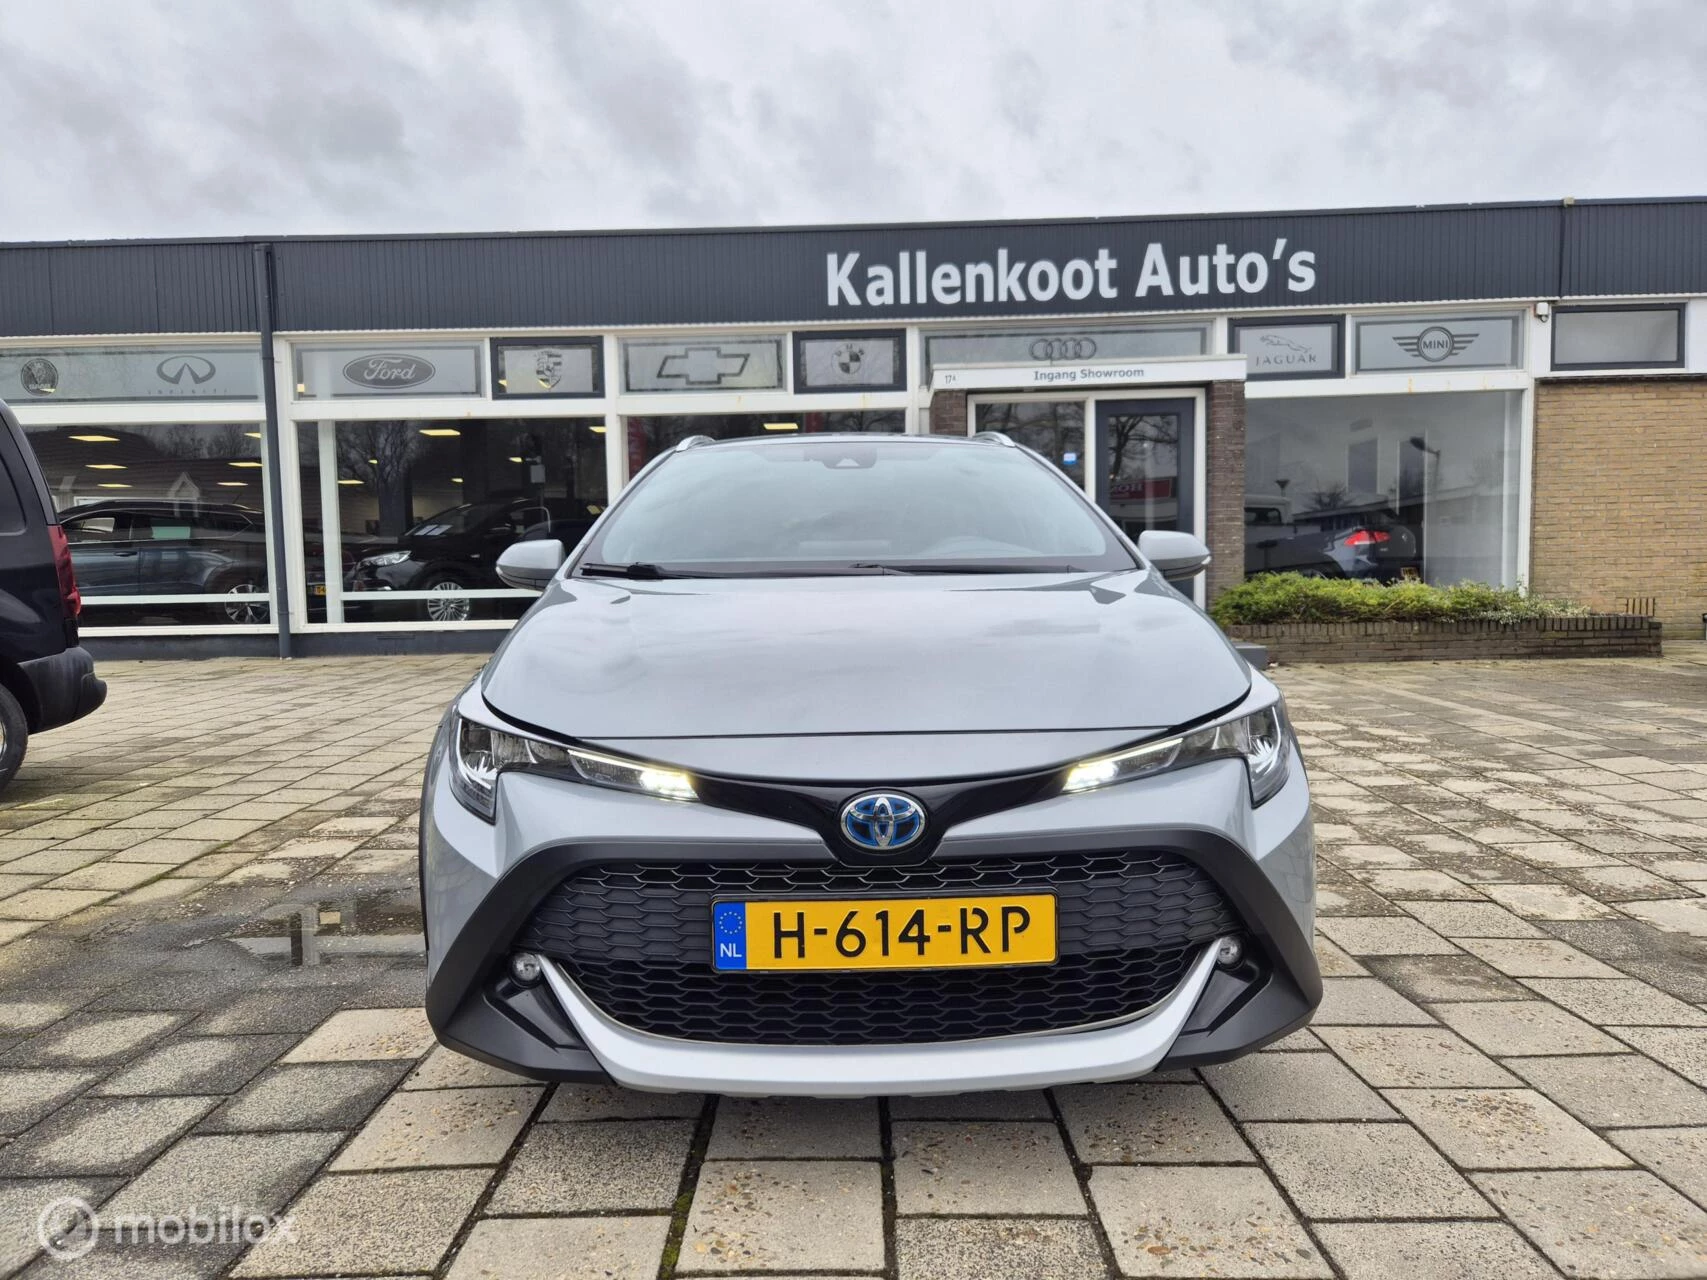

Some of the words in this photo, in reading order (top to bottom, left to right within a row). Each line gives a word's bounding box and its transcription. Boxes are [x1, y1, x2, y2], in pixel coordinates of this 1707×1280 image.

[827, 249, 1118, 306] Kallenkoot
[1135, 238, 1317, 297] Auto's
[1422, 340, 1449, 349] MINI
[1255, 353, 1317, 367] JAGUAR
[363, 359, 417, 380] Ford
[1034, 370, 1077, 382] Ingang
[1080, 368, 1144, 379] Showroom
[772, 905, 1032, 959] H-614-RP
[719, 943, 742, 958] NL
